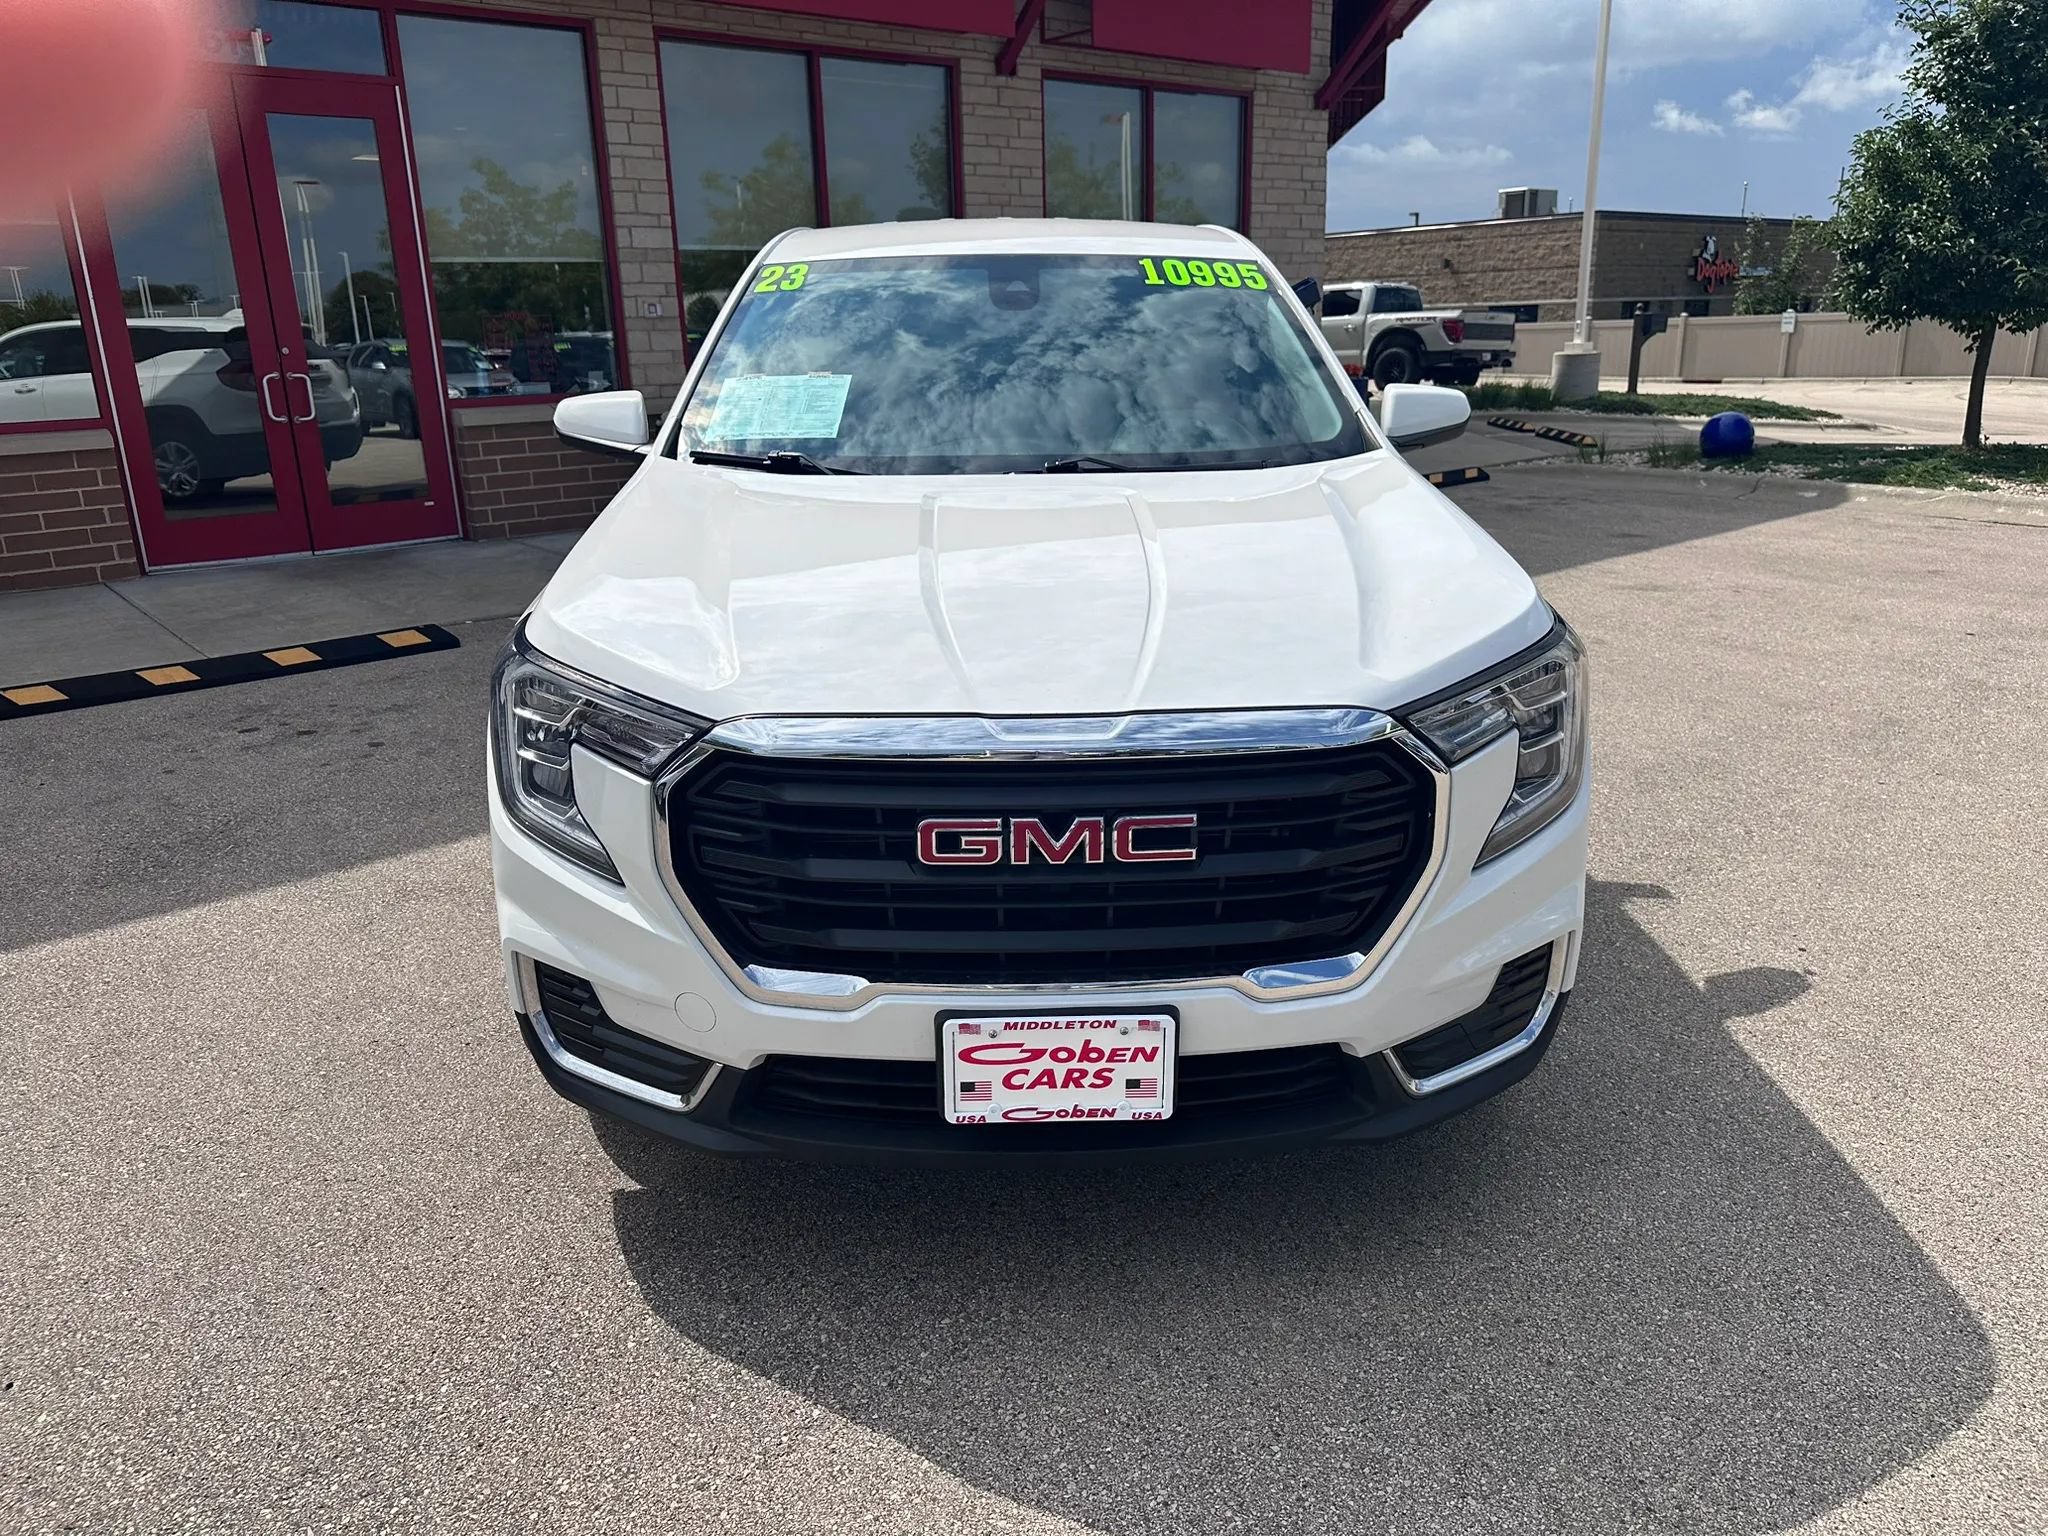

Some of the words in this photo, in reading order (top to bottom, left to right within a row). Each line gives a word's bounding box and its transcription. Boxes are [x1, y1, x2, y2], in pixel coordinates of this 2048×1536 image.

[753, 264, 809, 293] 23
[1138, 258, 1268, 290] 10995
[917, 814, 1198, 866] GMC
[1003, 1019, 1117, 1031] MIDDLETON
[1001, 1067, 1115, 1091] CARS
[955, 1115, 987, 1124] USA
[1131, 1111, 1163, 1120] USA
